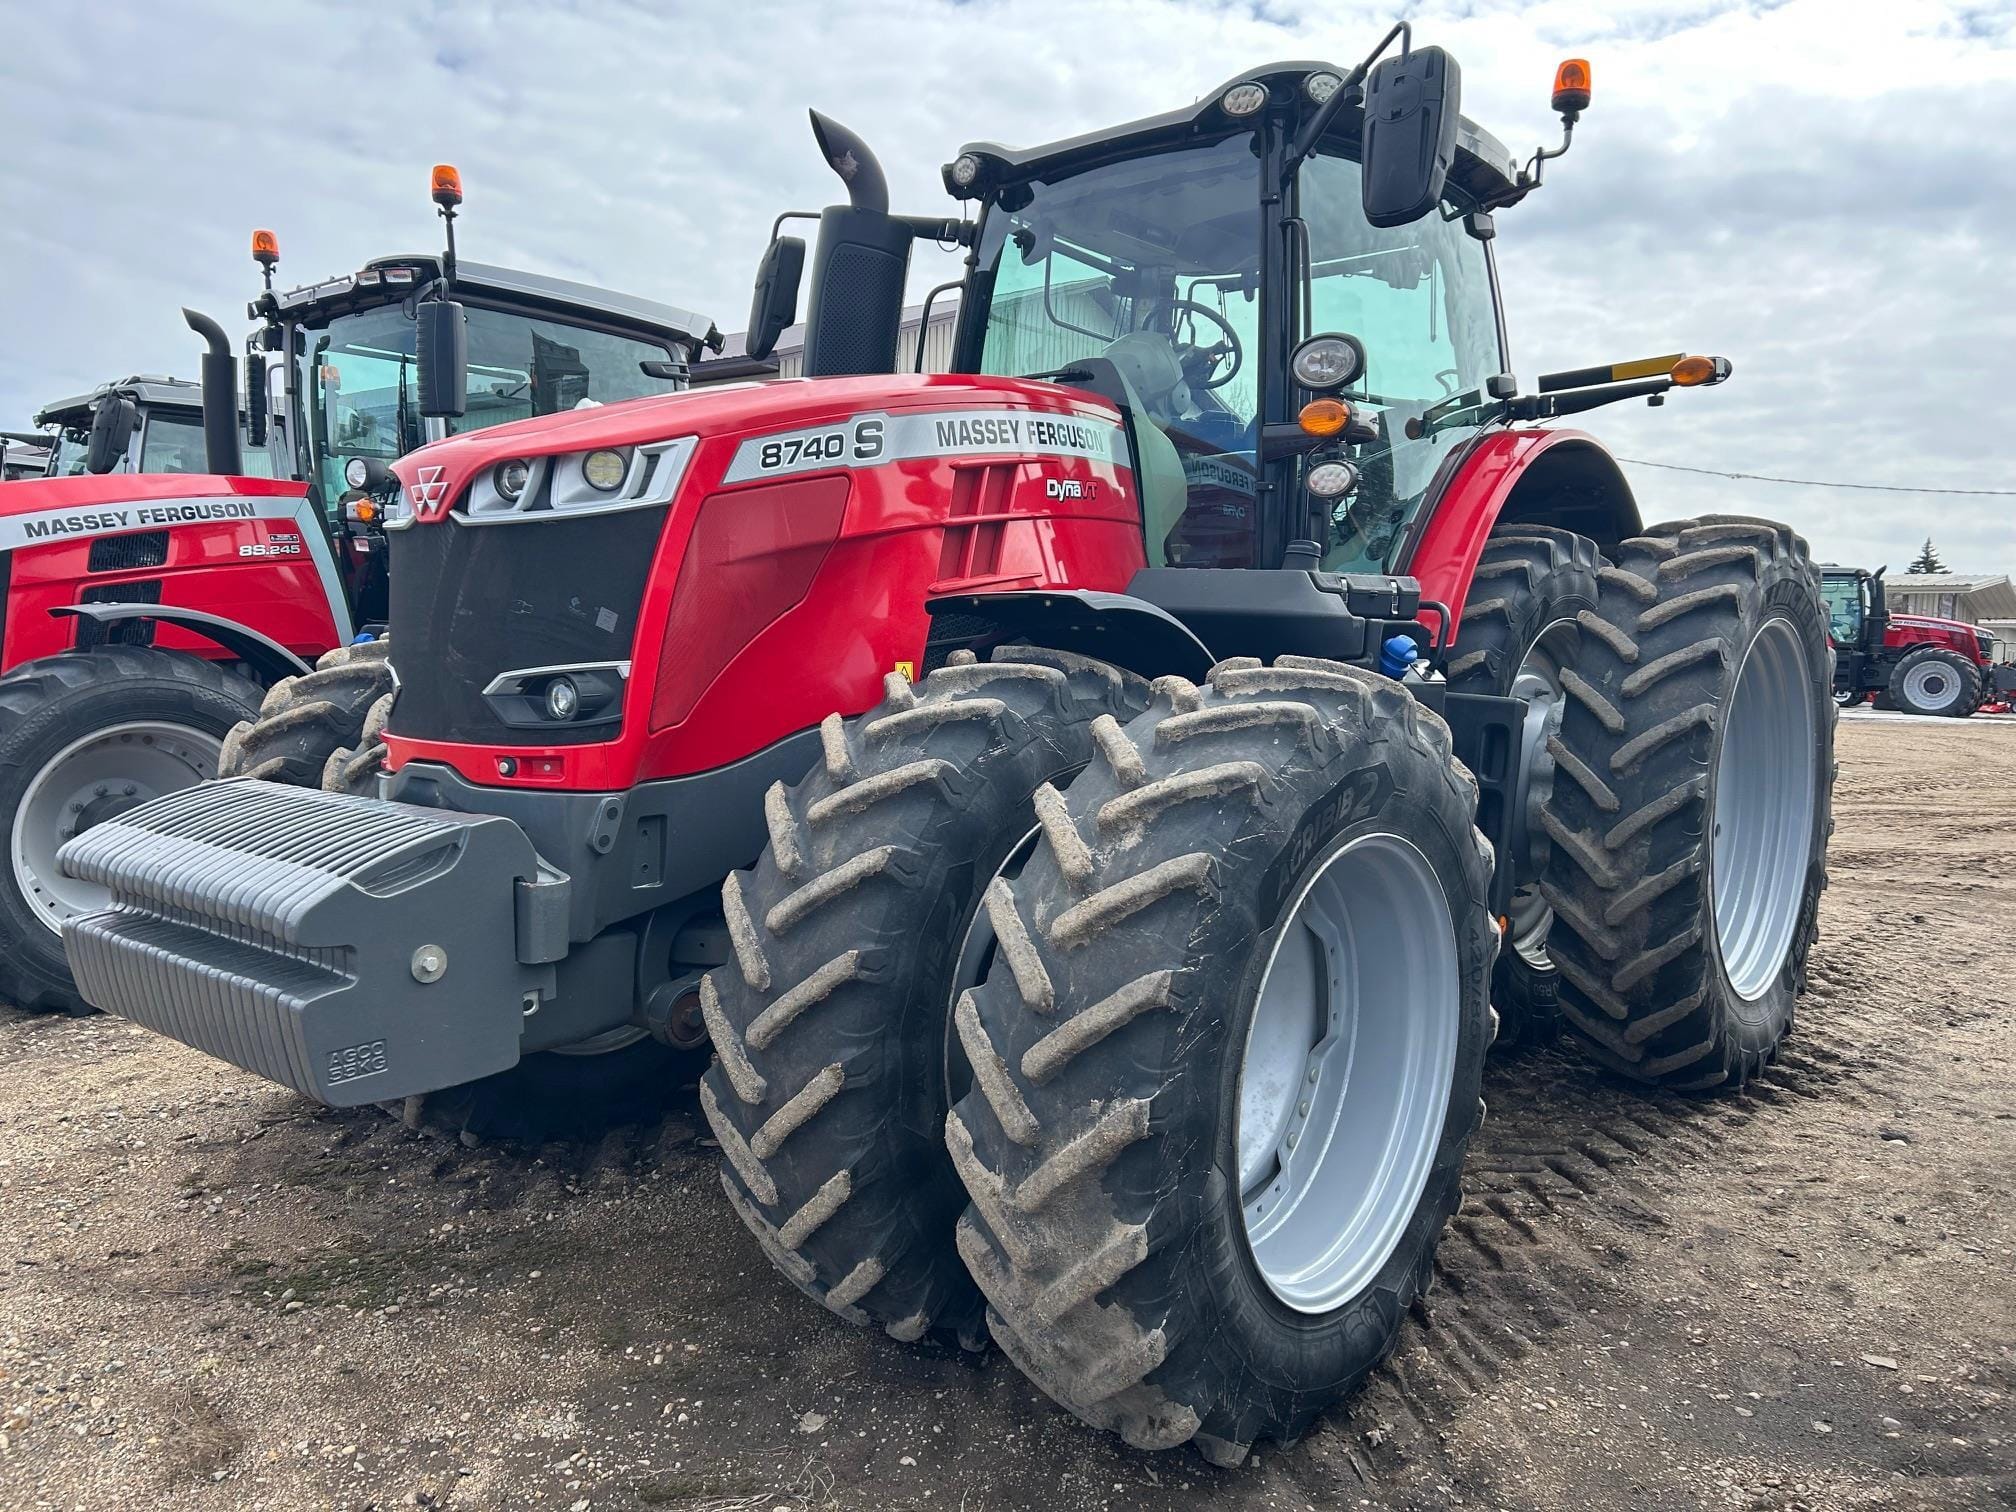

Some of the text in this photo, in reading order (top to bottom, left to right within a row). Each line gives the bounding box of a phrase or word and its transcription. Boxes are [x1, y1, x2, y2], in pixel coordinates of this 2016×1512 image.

[761, 419, 1104, 469] 8740 S MASSEY FERGUSON
[23, 502, 256, 538] MASSEY FERGUSON
[239, 544, 301, 558] 8S.245
[328, 1041, 385, 1066] AGCO
[328, 1055, 387, 1081] 55KG
